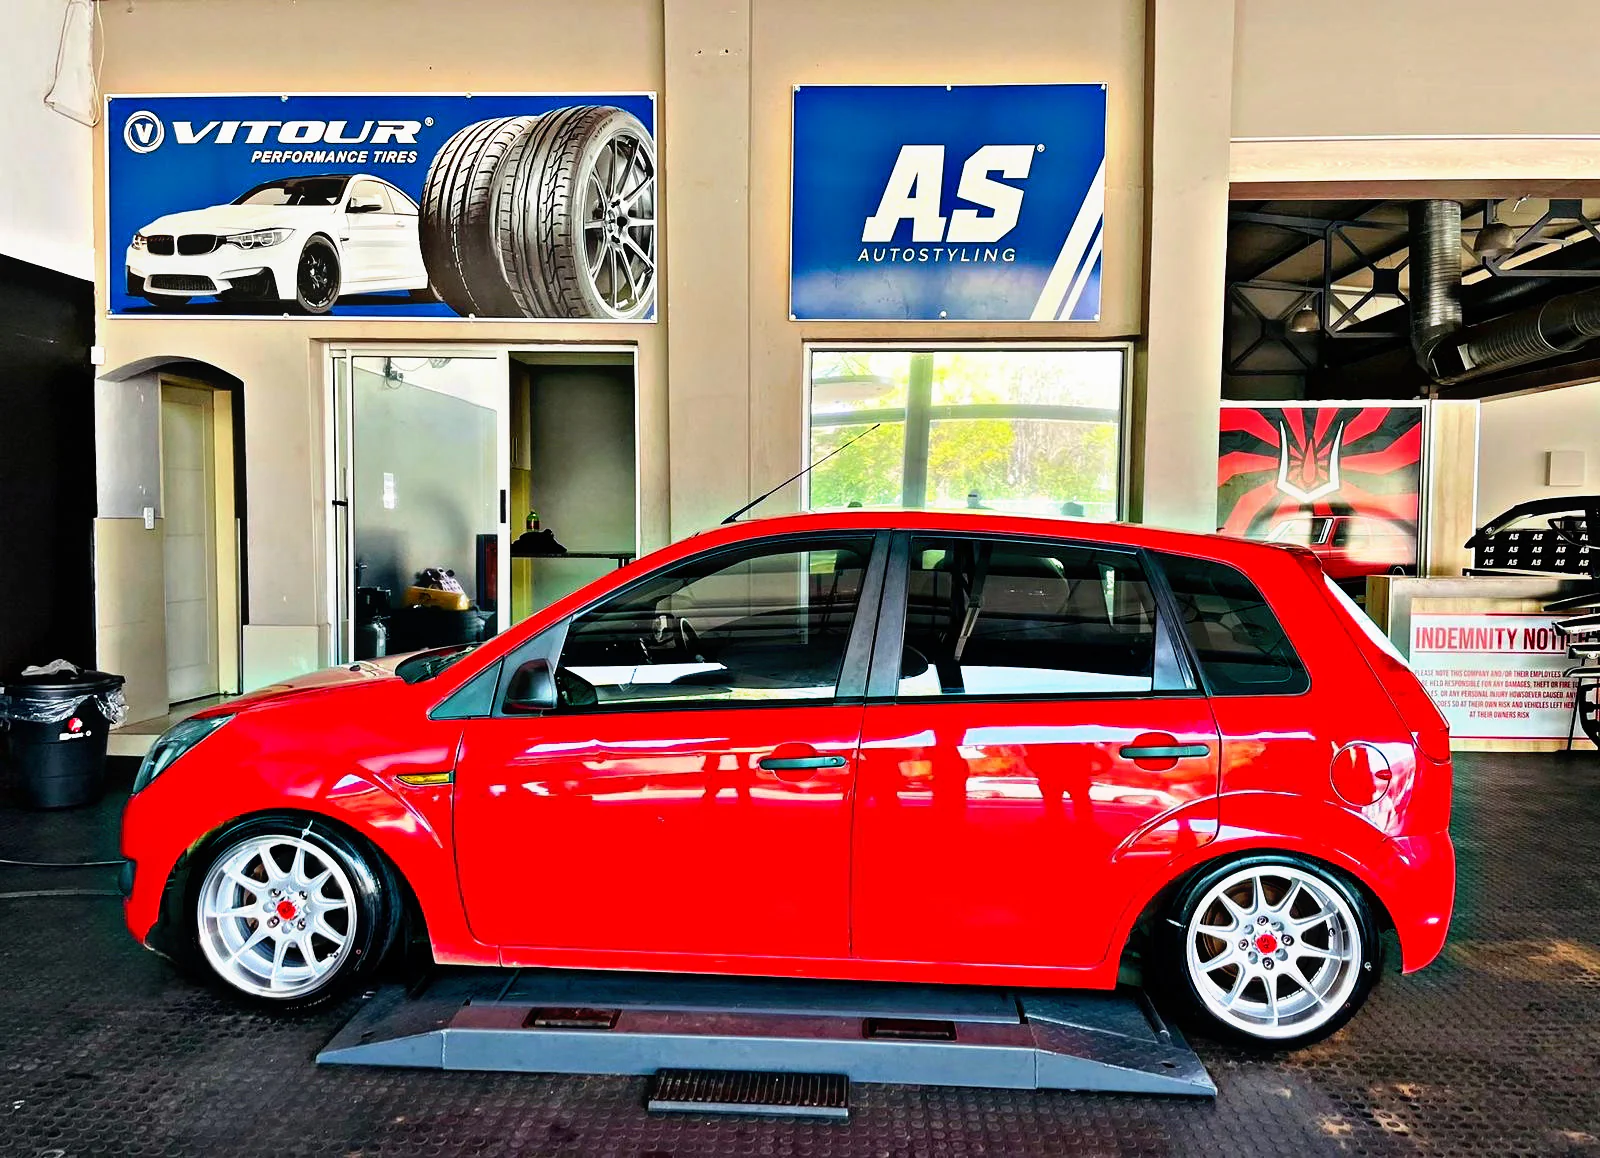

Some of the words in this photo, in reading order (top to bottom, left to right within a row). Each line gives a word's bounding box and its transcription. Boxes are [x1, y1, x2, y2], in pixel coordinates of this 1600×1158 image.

[172, 120, 422, 144] VITOUR
[251, 151, 367, 164] PERFORMANCE
[373, 151, 418, 164] TIRES
[861, 144, 1036, 243] AS
[858, 248, 1016, 262] AUTOSTYLING
[1415, 627, 1517, 650] INDEMNITY
[1513, 670, 1529, 678] THEIR
[1530, 670, 1561, 678] EMPLOYEES
[1461, 690, 1489, 698] PERSONAL
[1468, 700, 1484, 708] THEIR
[1484, 700, 1497, 708] OWN
[1523, 701, 1550, 709] VEHICLES
